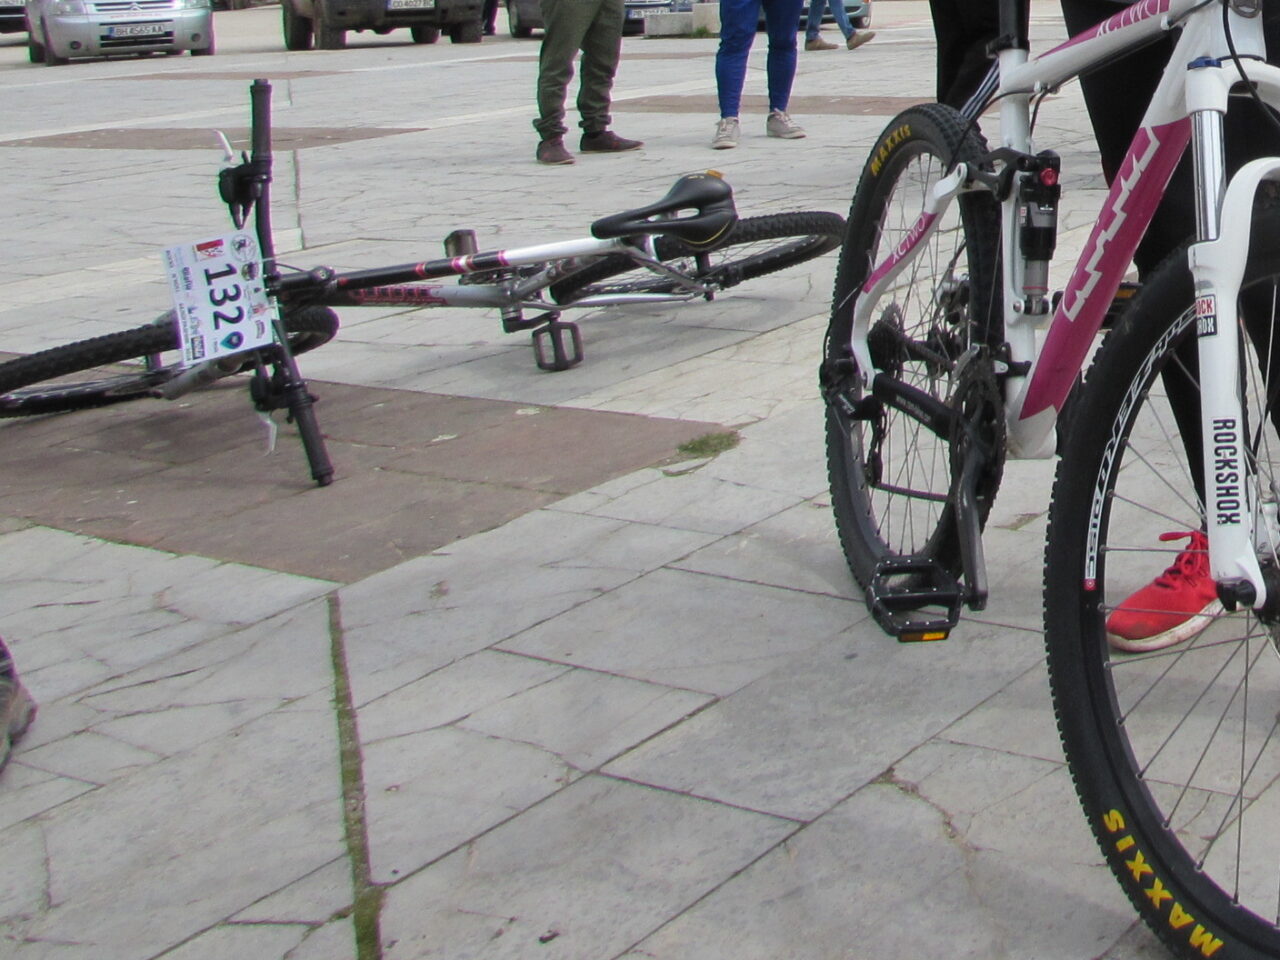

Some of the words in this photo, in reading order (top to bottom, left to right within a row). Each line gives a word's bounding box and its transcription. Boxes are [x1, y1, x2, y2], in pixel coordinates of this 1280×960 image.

[870, 124, 912, 176] MAXXIS
[203, 263, 245, 330] 132
[1212, 418, 1241, 526] ROCKSHOX
[1103, 808, 1225, 958] MAXXIS
